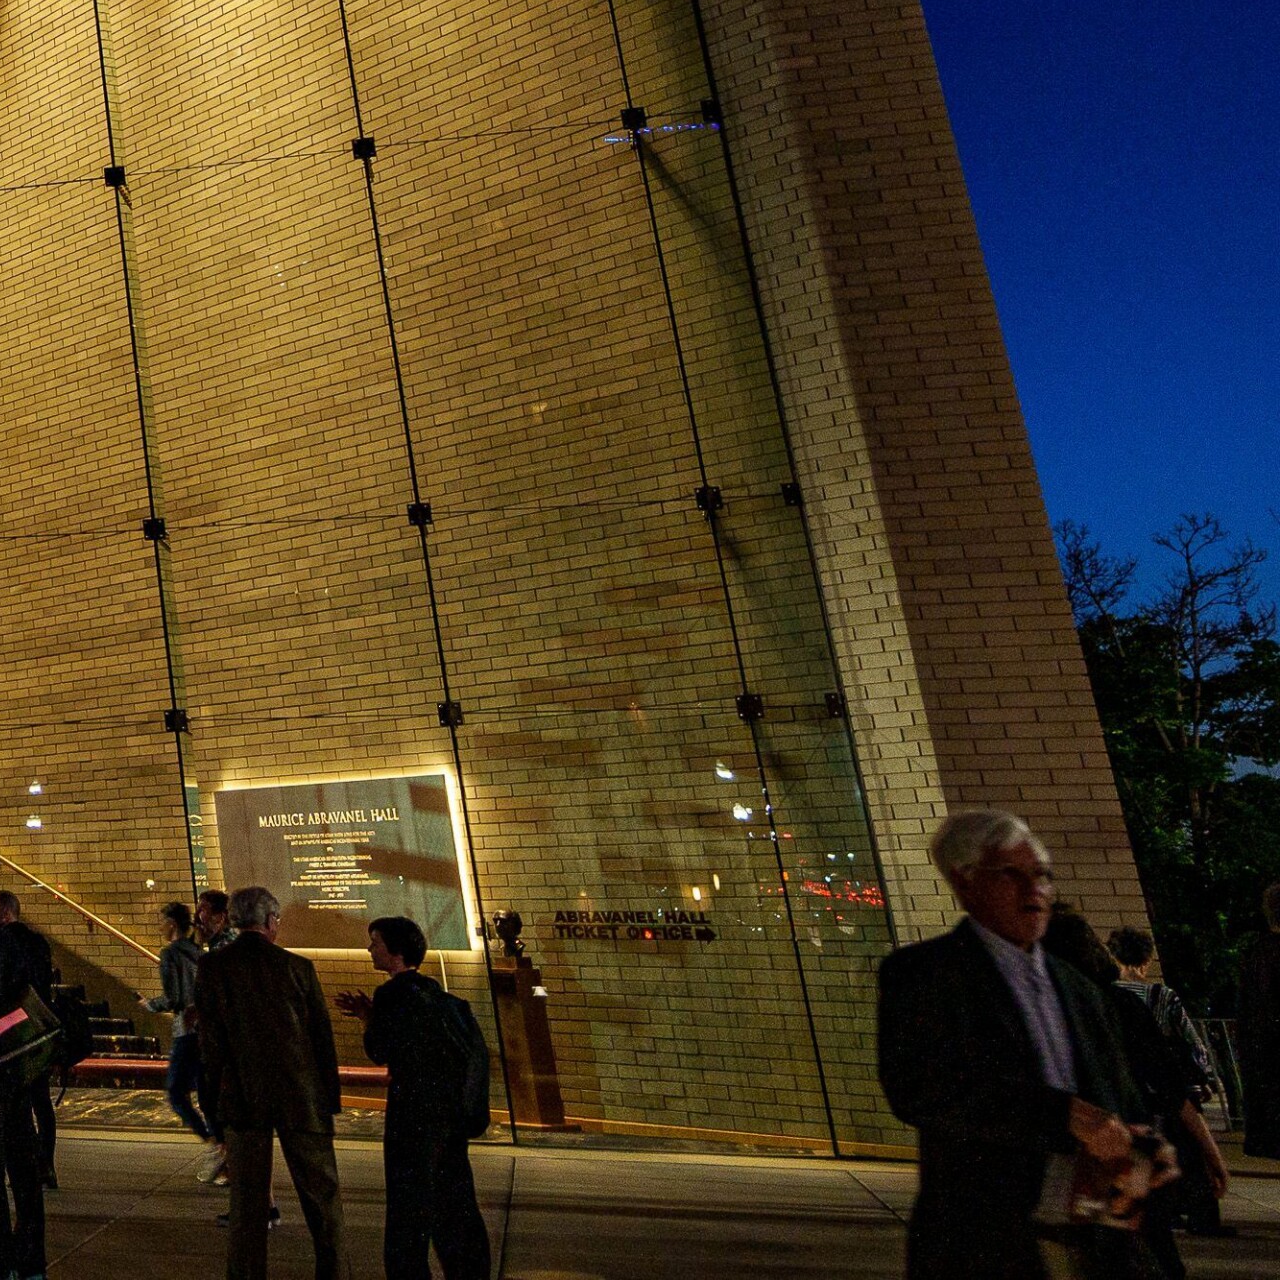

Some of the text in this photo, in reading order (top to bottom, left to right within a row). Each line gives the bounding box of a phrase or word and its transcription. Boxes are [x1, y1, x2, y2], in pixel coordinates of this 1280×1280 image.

[259, 808, 400, 827] MAURICE ABRAVANEL HALL
[554, 910, 711, 924] ABRAVANEL HALL
[555, 925, 694, 940] TICKET OFICE
